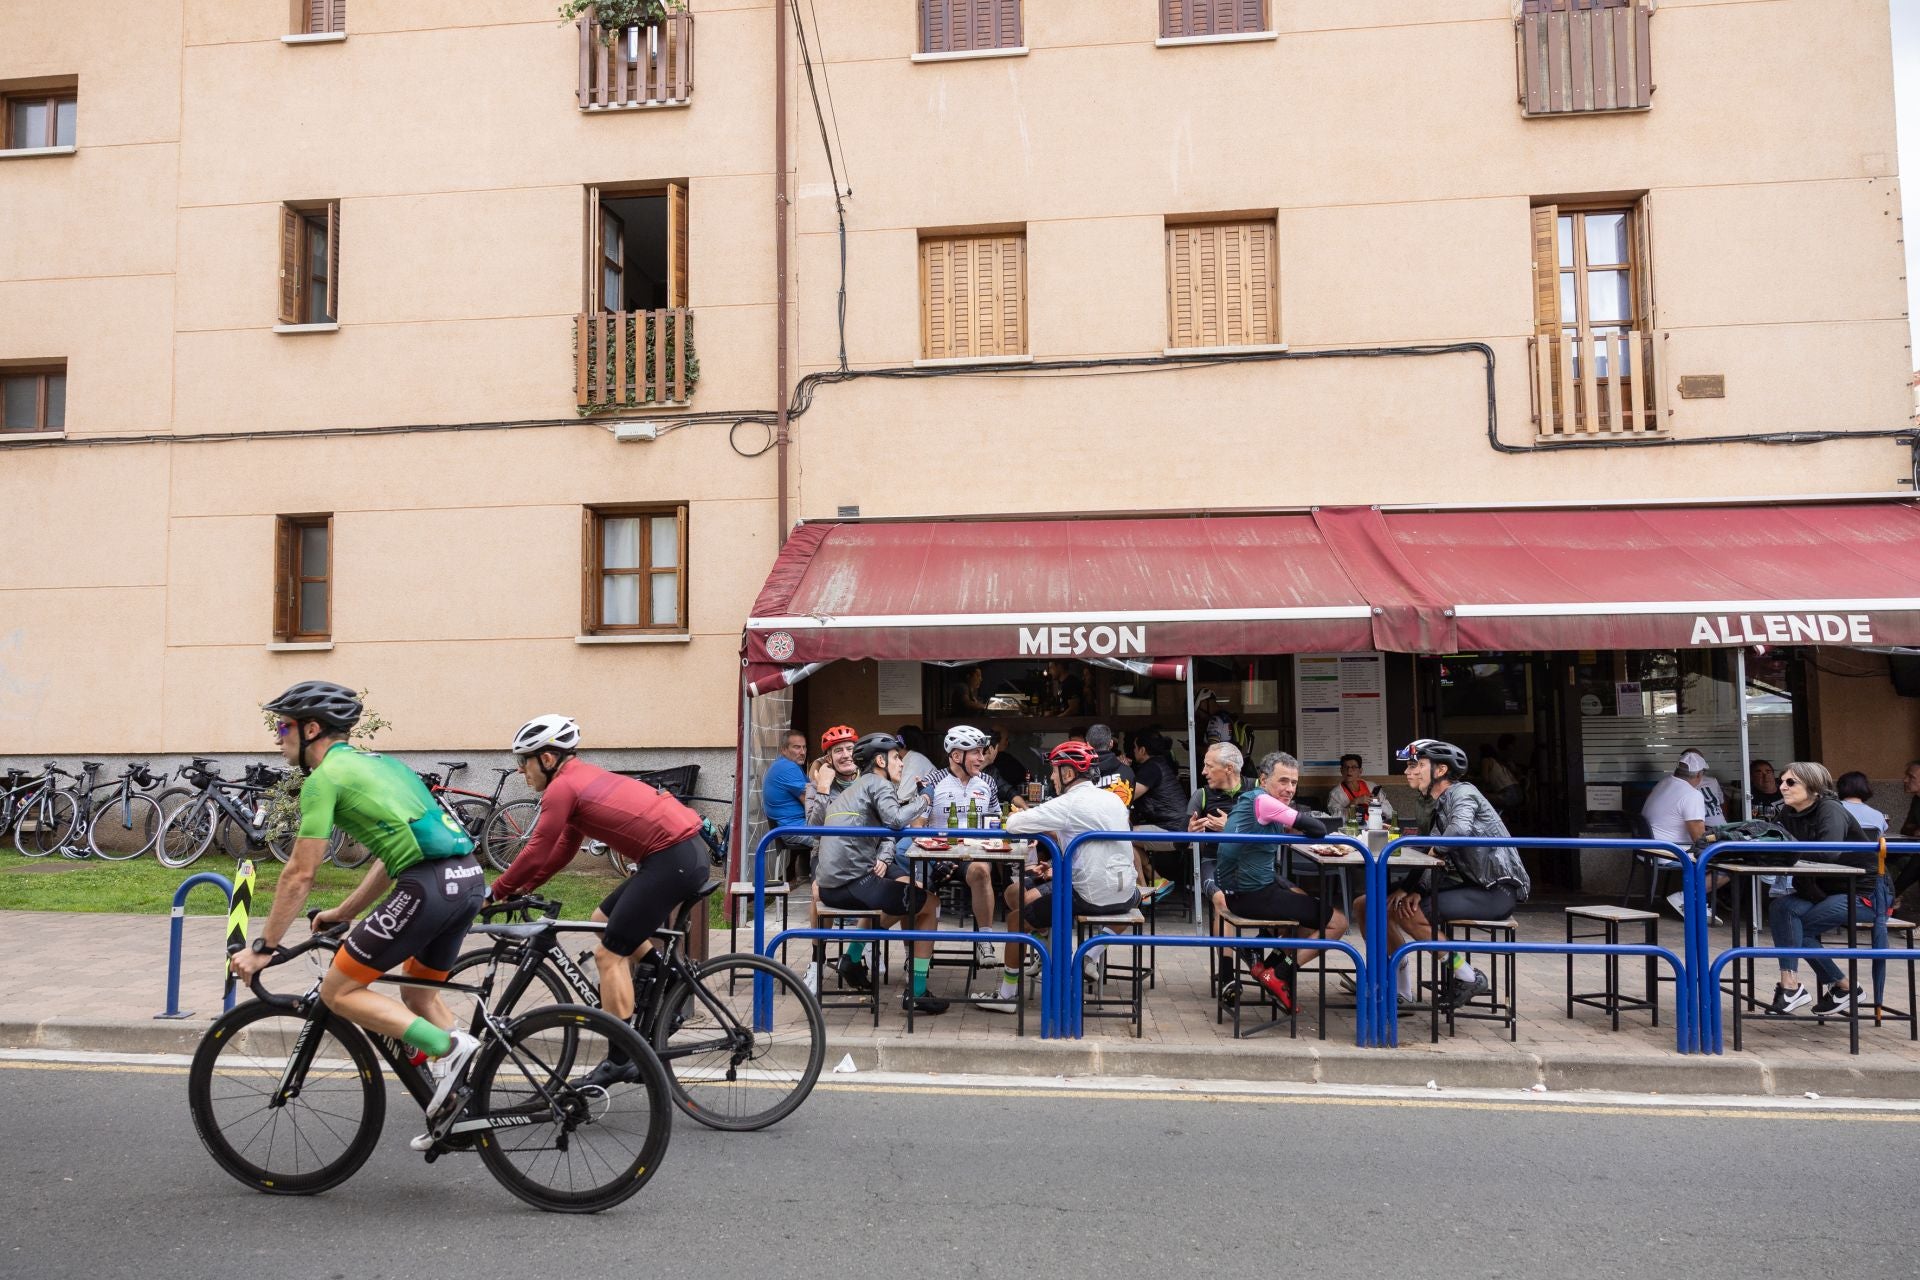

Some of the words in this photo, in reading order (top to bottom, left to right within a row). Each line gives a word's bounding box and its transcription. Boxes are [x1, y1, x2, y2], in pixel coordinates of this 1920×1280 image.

[1019, 625, 1146, 656] MESON
[1690, 614, 1873, 645] ALLENDE
[549, 946, 600, 1009] PINAREL
[489, 1116, 532, 1127] CANYON
